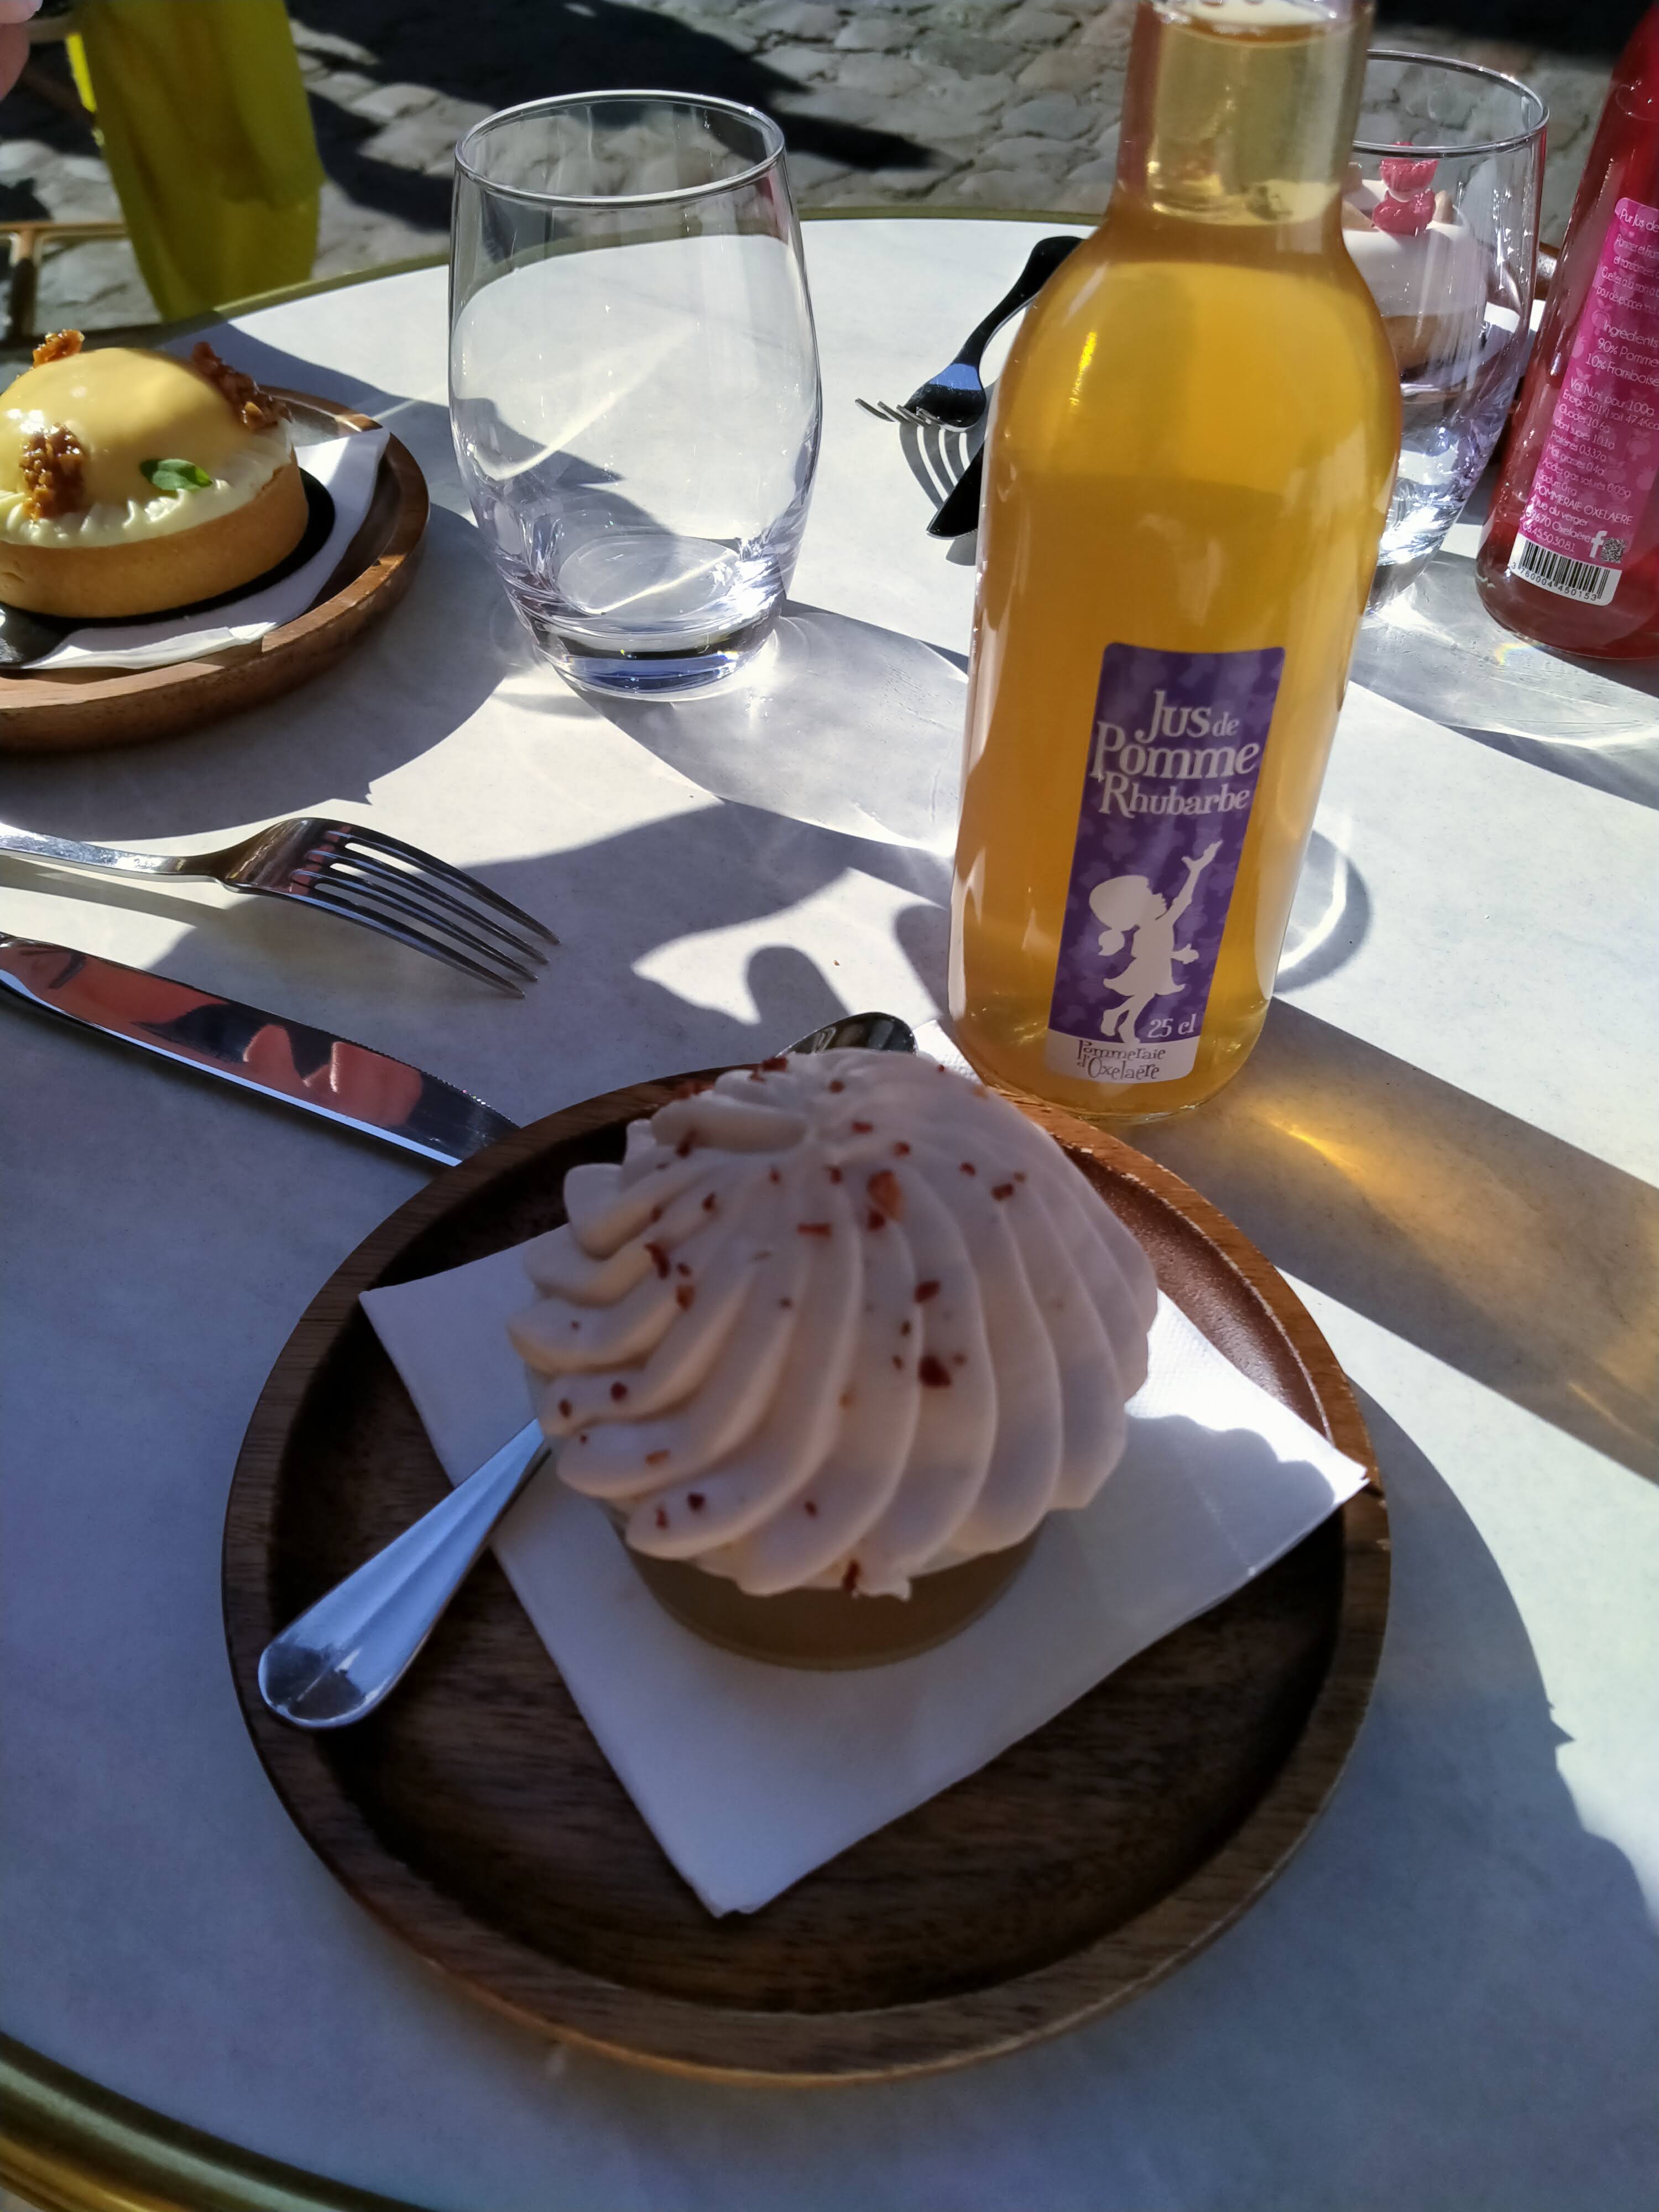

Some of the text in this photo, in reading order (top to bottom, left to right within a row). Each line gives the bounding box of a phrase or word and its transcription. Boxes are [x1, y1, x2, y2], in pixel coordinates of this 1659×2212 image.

[1619, 208, 1633, 223] Pur
[1603, 319, 1659, 348] Ingrédients
[1598, 337, 1659, 367] 90% Pomme
[1585, 353, 1659, 387] 10% Framboise
[1604, 395, 1626, 408] pour
[1627, 399, 1655, 417] 100g
[1533, 482, 1583, 513] POMMERAIE
[1549, 505, 1559, 517] du
[1561, 512, 1589, 526] verger
[1134, 688, 1240, 744] Jus de
[1090, 721, 1261, 780] Pomme
[1098, 771, 1250, 819] Rhubarbe
[1147, 1013, 1197, 1039] 25 cl
[1076, 1039, 1166, 1061] Pommeraie
